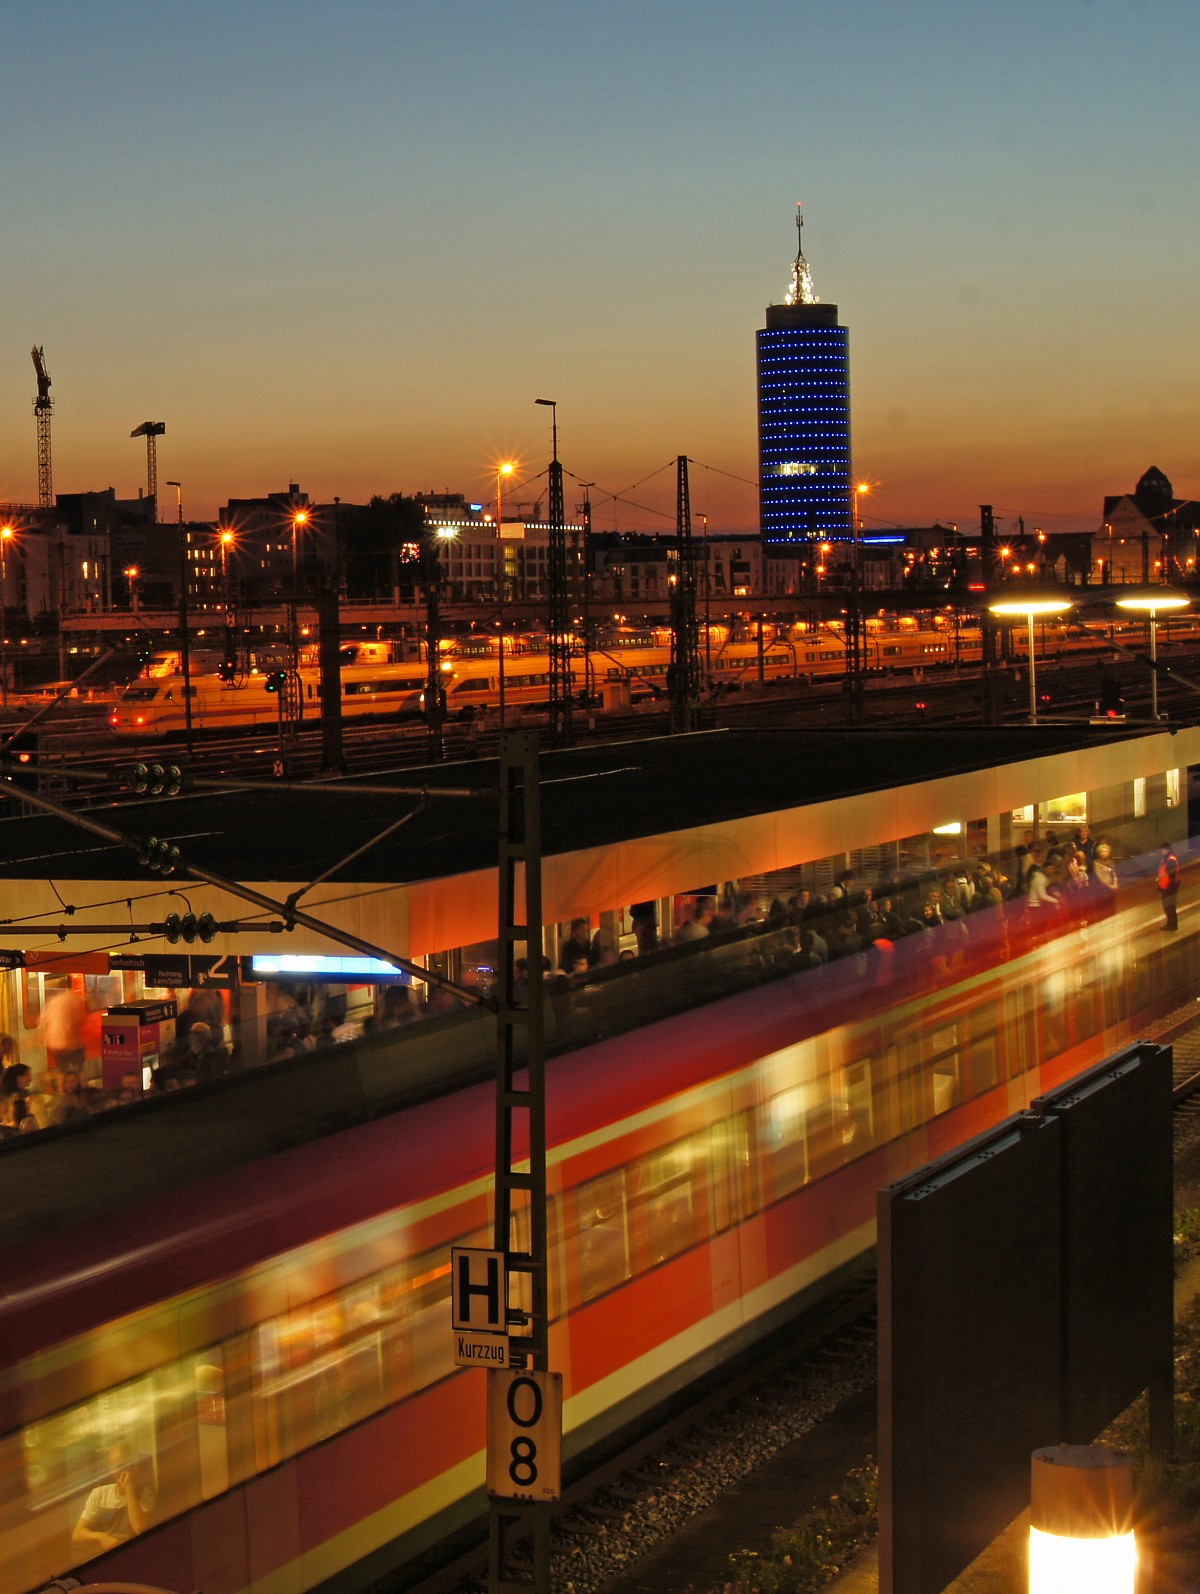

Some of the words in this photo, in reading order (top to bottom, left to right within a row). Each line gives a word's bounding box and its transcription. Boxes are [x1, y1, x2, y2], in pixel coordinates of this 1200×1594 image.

[458, 1255, 499, 1325] H
[458, 1337, 504, 1364] Kurzzug
[507, 1376, 543, 1428] 0
[508, 1436, 538, 1487] 8
